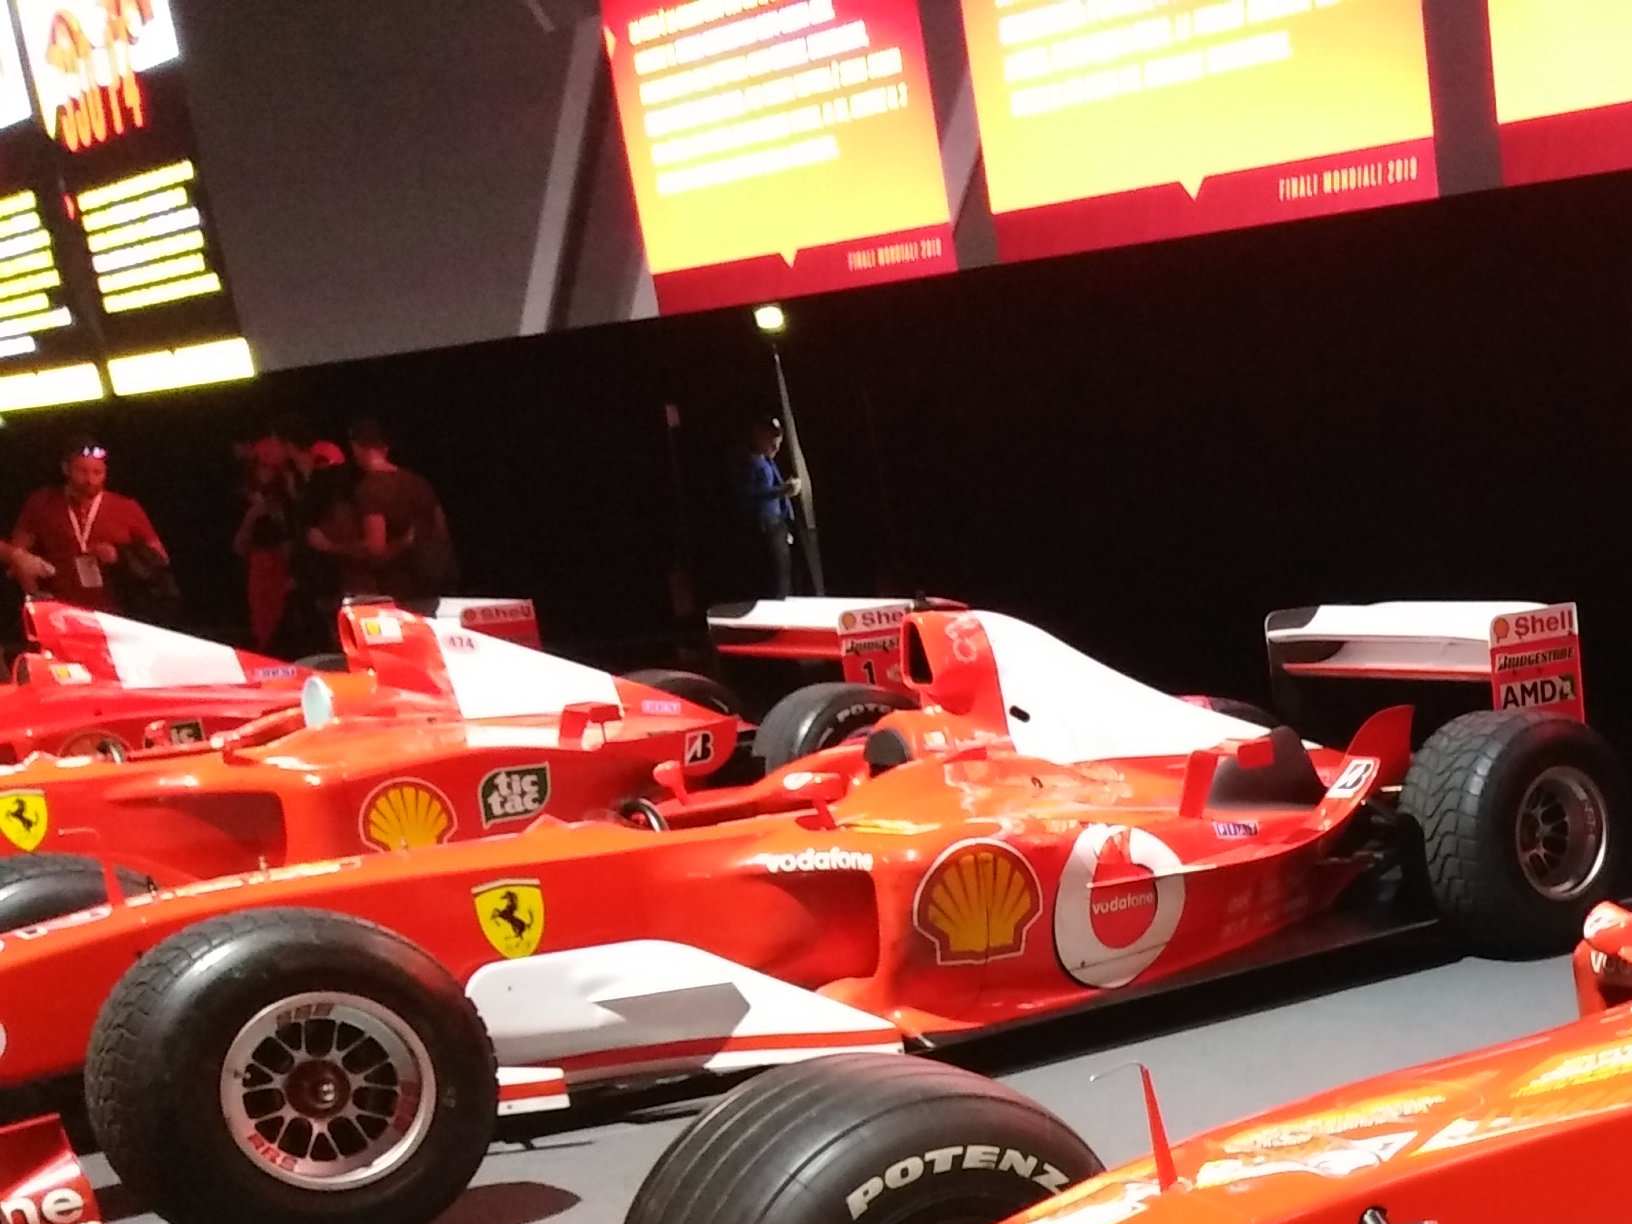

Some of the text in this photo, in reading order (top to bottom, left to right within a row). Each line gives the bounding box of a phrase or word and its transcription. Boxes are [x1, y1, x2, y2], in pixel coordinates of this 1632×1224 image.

[1279, 156, 1417, 201] FINALI MONDIALI 2019
[861, 610, 904, 628] She
[1514, 609, 1573, 637] Shell
[1498, 647, 1574, 671] BRIDGESTONE
[1502, 679, 1557, 710] AMD
[493, 772, 539, 797] tic
[487, 790, 540, 815] tac
[765, 846, 873, 873] vodafone
[1092, 890, 1155, 915] vodafone
[846, 1144, 1070, 1221] POTENZ
